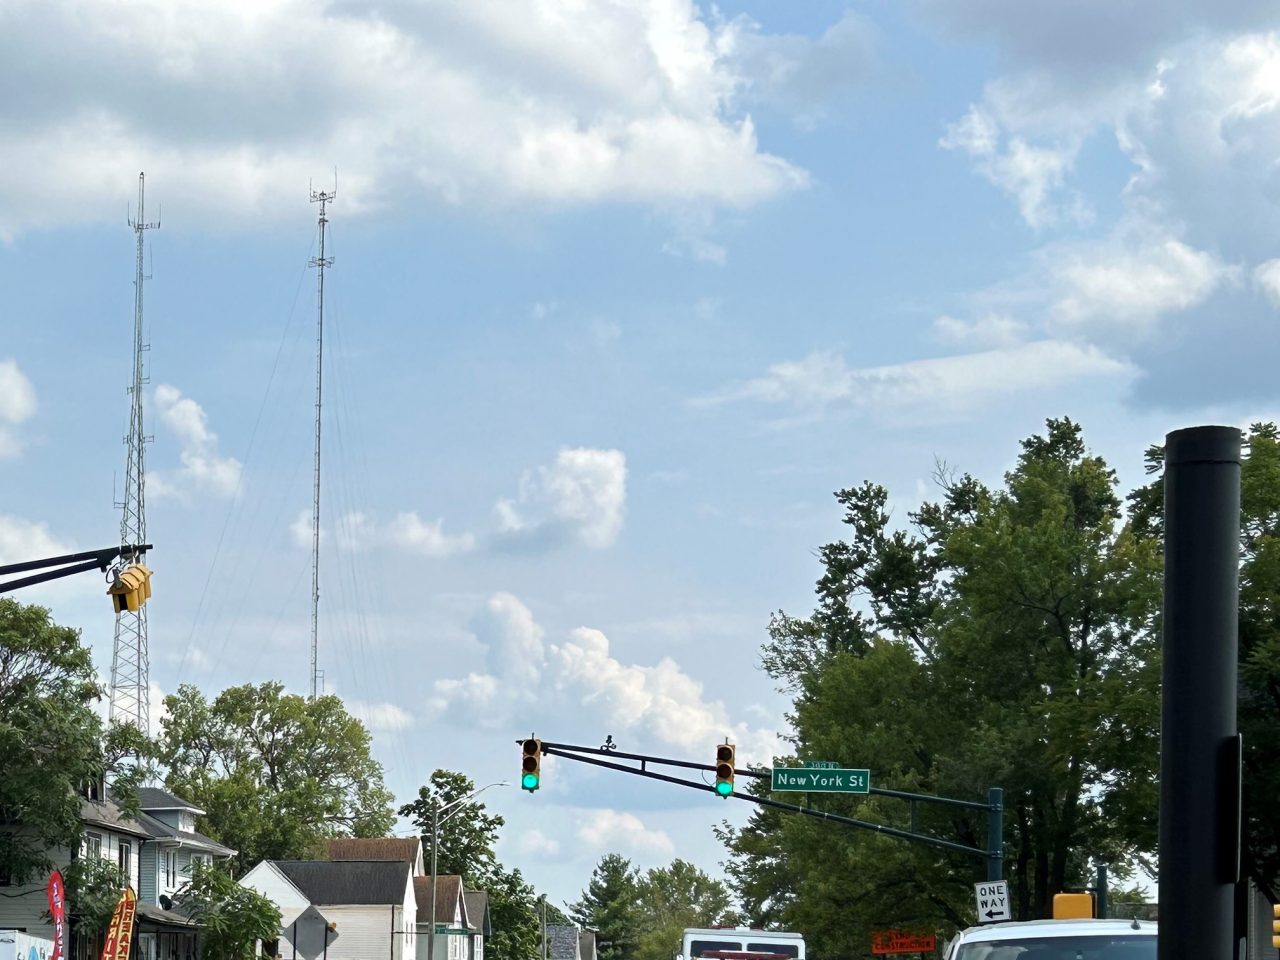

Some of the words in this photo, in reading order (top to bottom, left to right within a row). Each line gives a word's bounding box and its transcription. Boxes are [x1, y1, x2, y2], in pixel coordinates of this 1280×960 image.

[778, 773, 807, 786] New
[810, 774, 843, 787] York
[849, 775, 864, 788] St
[980, 885, 1005, 897] ONE
[980, 897, 1005, 908] WAY
